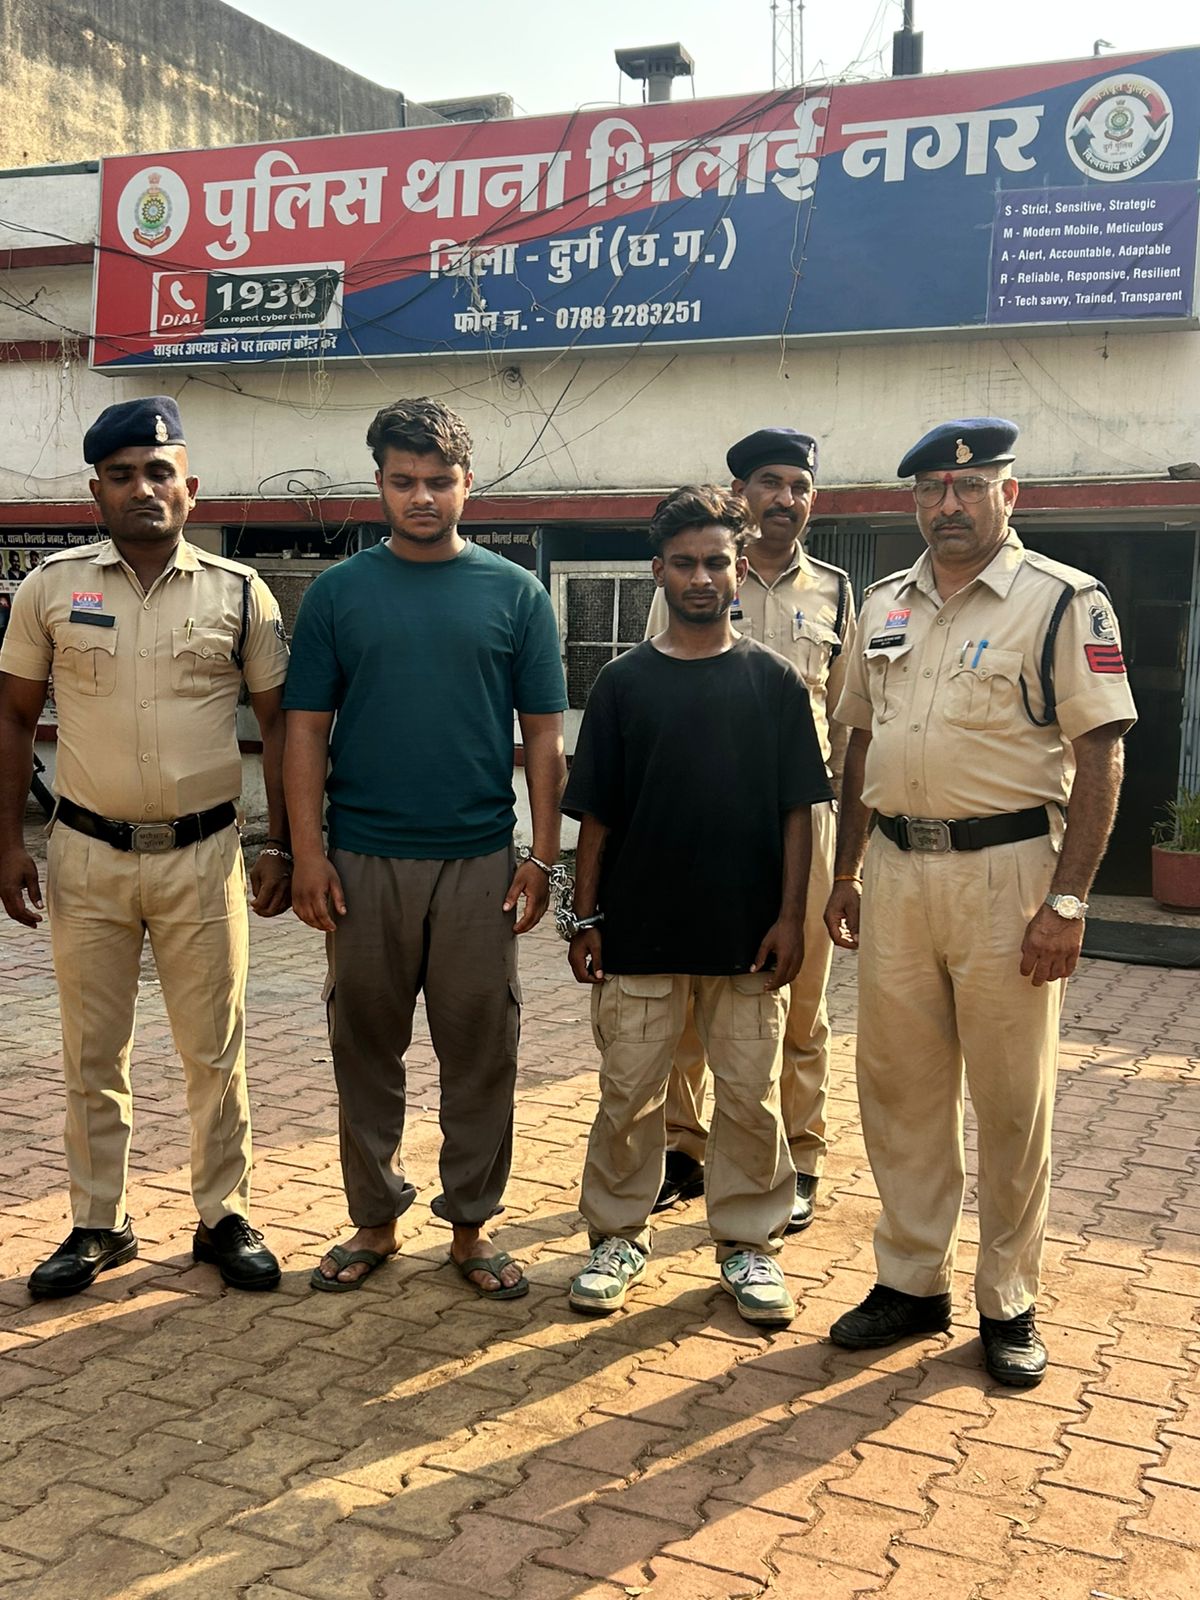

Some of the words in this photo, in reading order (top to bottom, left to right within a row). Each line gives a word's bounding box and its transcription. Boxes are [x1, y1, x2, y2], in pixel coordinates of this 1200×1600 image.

[203, 150, 388, 260] पुलिस
[401, 151, 571, 219] थाना
[586, 97, 830, 207] भिलाई
[841, 104, 1044, 182] नगर
[1004, 205, 1012, 217] S
[1021, 203, 1051, 215] Strict,
[1055, 200, 1105, 213] Sensitive,
[1109, 198, 1156, 212] Strategic
[1003, 228, 1013, 239] M
[1023, 225, 1061, 238] Modern
[1064, 223, 1103, 236] Mobile,
[1106, 221, 1164, 234] Meticulous
[430, 238, 519, 279] जिला
[548, 226, 603, 284] दुर्ग
[609, 217, 737, 277] (छ.ग.)
[1001, 250, 1009, 261] A
[1018, 249, 1046, 261] Alert,
[1049, 246, 1115, 259] Accountable,
[1118, 244, 1171, 258] Adaptable
[1000, 273, 1008, 284] R
[1017, 271, 1063, 284] Reliable,
[1067, 268, 1130, 283] Responsive,
[1133, 266, 1181, 279] Resilient
[216, 277, 316, 311] 1930
[998, 296, 1006, 307] T
[1014, 294, 1038, 306] Tech
[1074, 292, 1117, 304] Trained,
[1120, 290, 1182, 304] Transparent
[219, 315, 229, 324] to
[231, 314, 259, 324] report
[261, 312, 287, 323] cyber
[454, 306, 500, 333] फोन
[556, 305, 606, 329] 0788
[611, 300, 701, 328] 2283251
[153, 343, 184, 358] साइबर
[185, 341, 219, 356] अपराध
[220, 337, 239, 353] होने
[240, 339, 254, 353] पर
[256, 337, 292, 352] तत्काल
